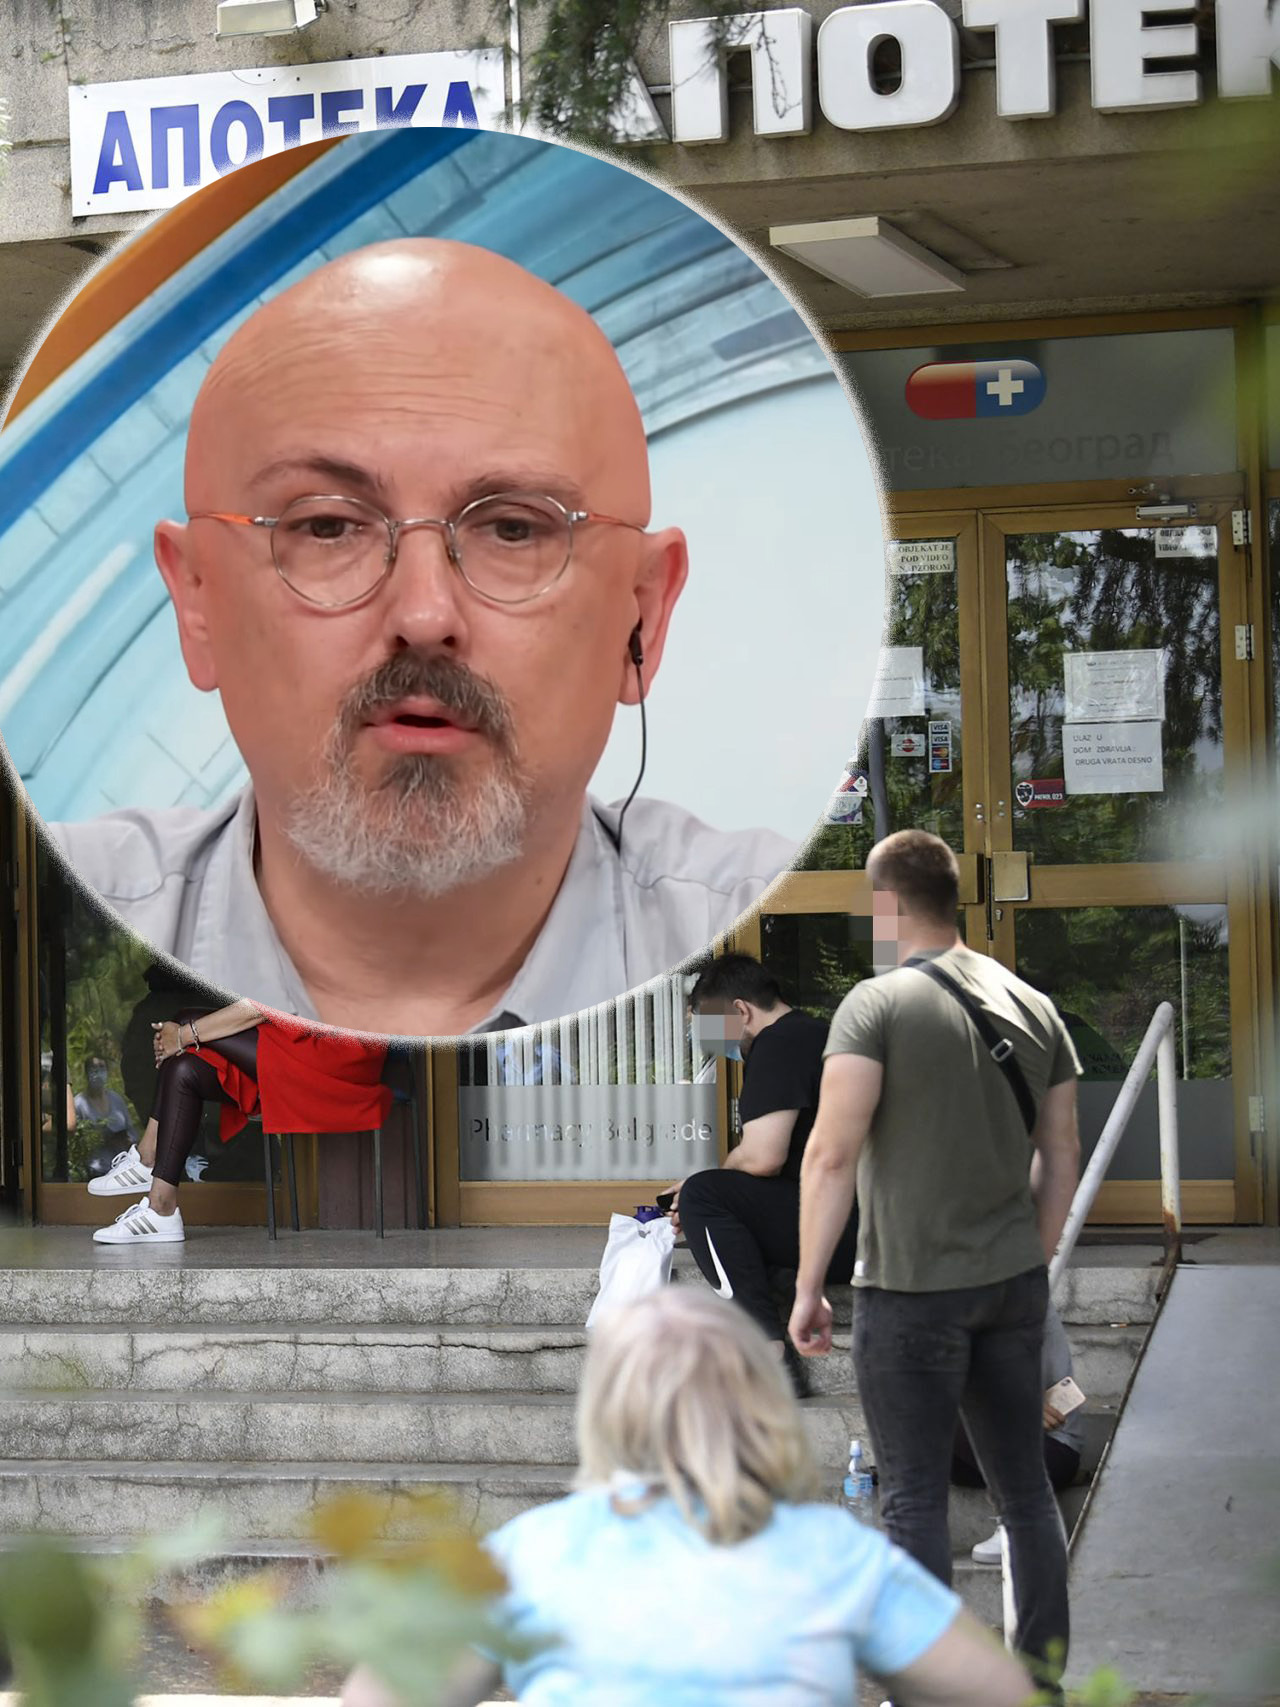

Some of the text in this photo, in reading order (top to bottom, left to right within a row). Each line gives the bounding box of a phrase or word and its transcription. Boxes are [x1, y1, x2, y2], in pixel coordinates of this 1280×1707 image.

[898, 543, 951, 553] OBJEKAT JE
[901, 554, 949, 563] POD VIDEO
[898, 563, 951, 572] NDZOROM
[607, 1117, 712, 1147] Belgade
